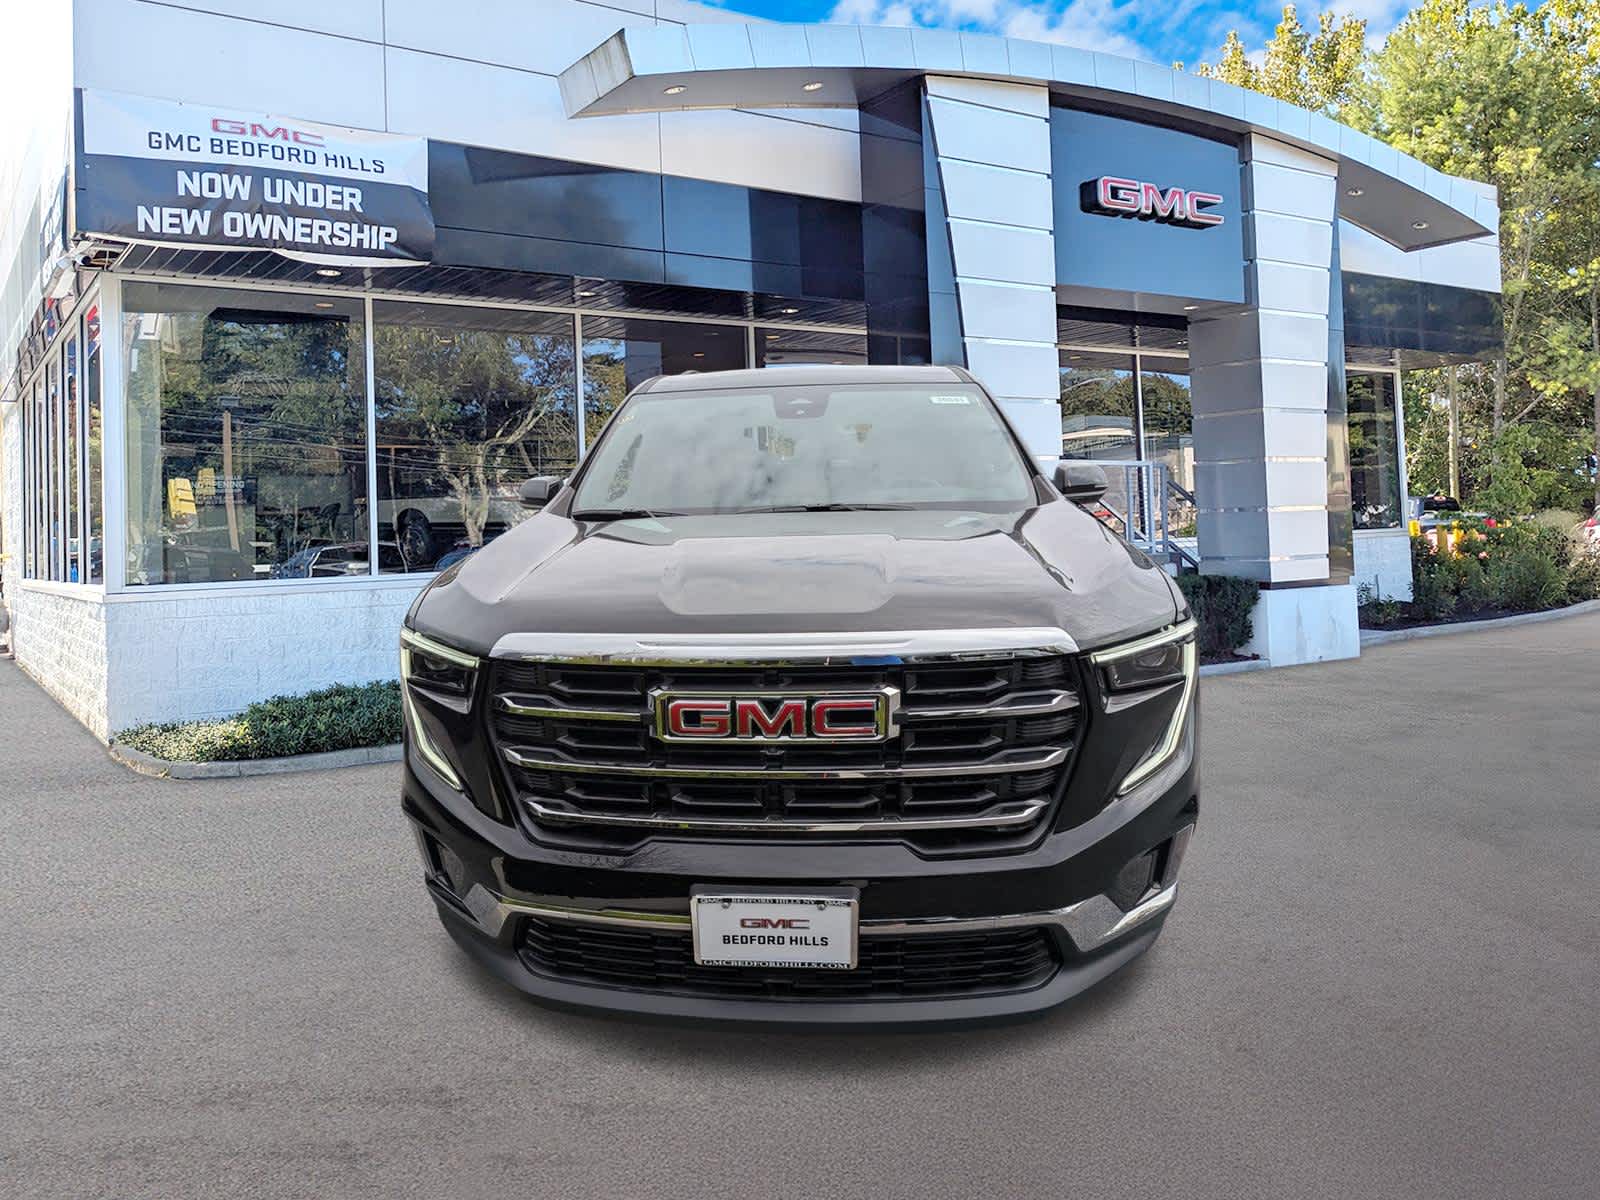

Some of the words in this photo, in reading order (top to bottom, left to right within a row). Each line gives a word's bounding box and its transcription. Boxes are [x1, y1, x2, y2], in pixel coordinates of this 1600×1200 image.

[148, 131, 201, 153] GMC
[210, 137, 317, 165] BEDFORD
[324, 152, 386, 174] HILLS
[211, 118, 326, 148] GMC
[176, 169, 253, 201] NOW
[263, 176, 364, 213] UNDER
[1097, 175, 1225, 225] GMC
[136, 205, 212, 236] NEW
[223, 211, 398, 250] OWNERSHIP
[667, 699, 878, 739] GMC
[722, 935, 785, 945] BEDFORD
[789, 936, 829, 946] HILLS
[740, 918, 810, 929] GMC
